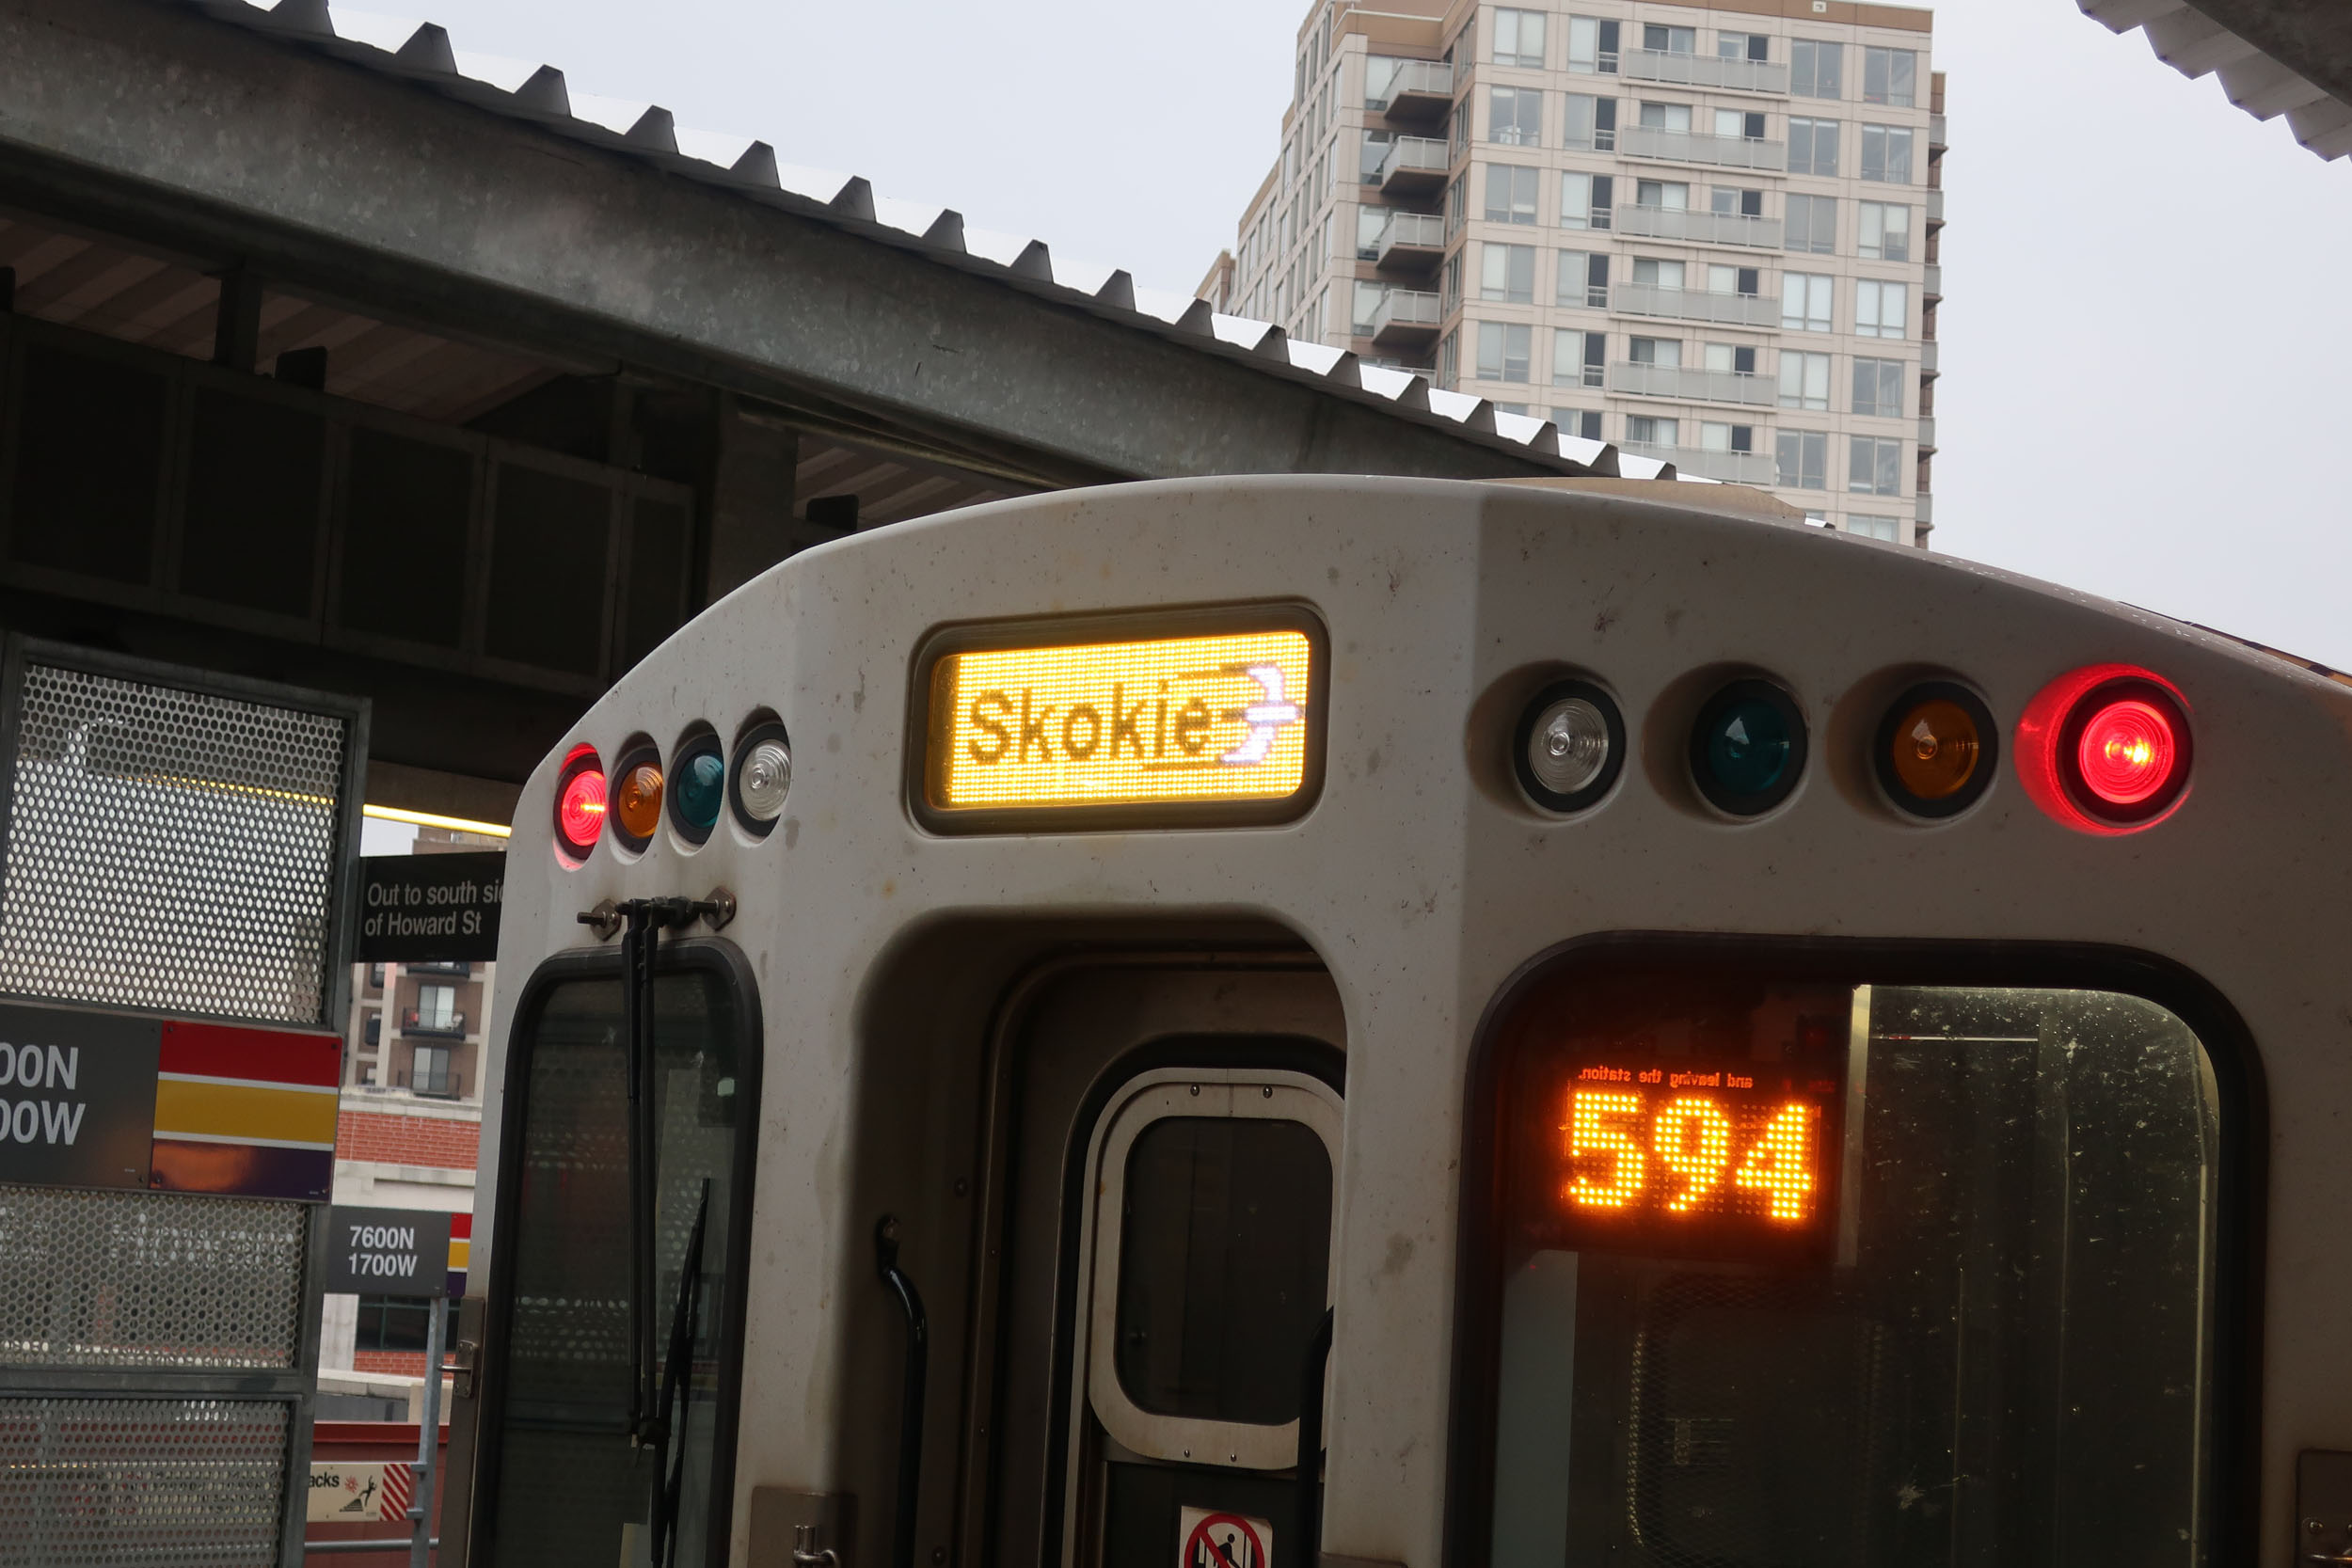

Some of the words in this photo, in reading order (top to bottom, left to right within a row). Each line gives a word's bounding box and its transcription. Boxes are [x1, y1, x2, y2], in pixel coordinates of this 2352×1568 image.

[968, 678, 1214, 767] Skokie
[368, 882, 401, 907] Out
[405, 882, 421, 905] to
[426, 879, 478, 906] south
[364, 911, 384, 937] of
[388, 910, 457, 937] Howard
[462, 909, 483, 935] St
[1569, 1091, 1812, 1220] 594
[349, 1225, 415, 1250] 7600N
[348, 1252, 419, 1277] 1700W
